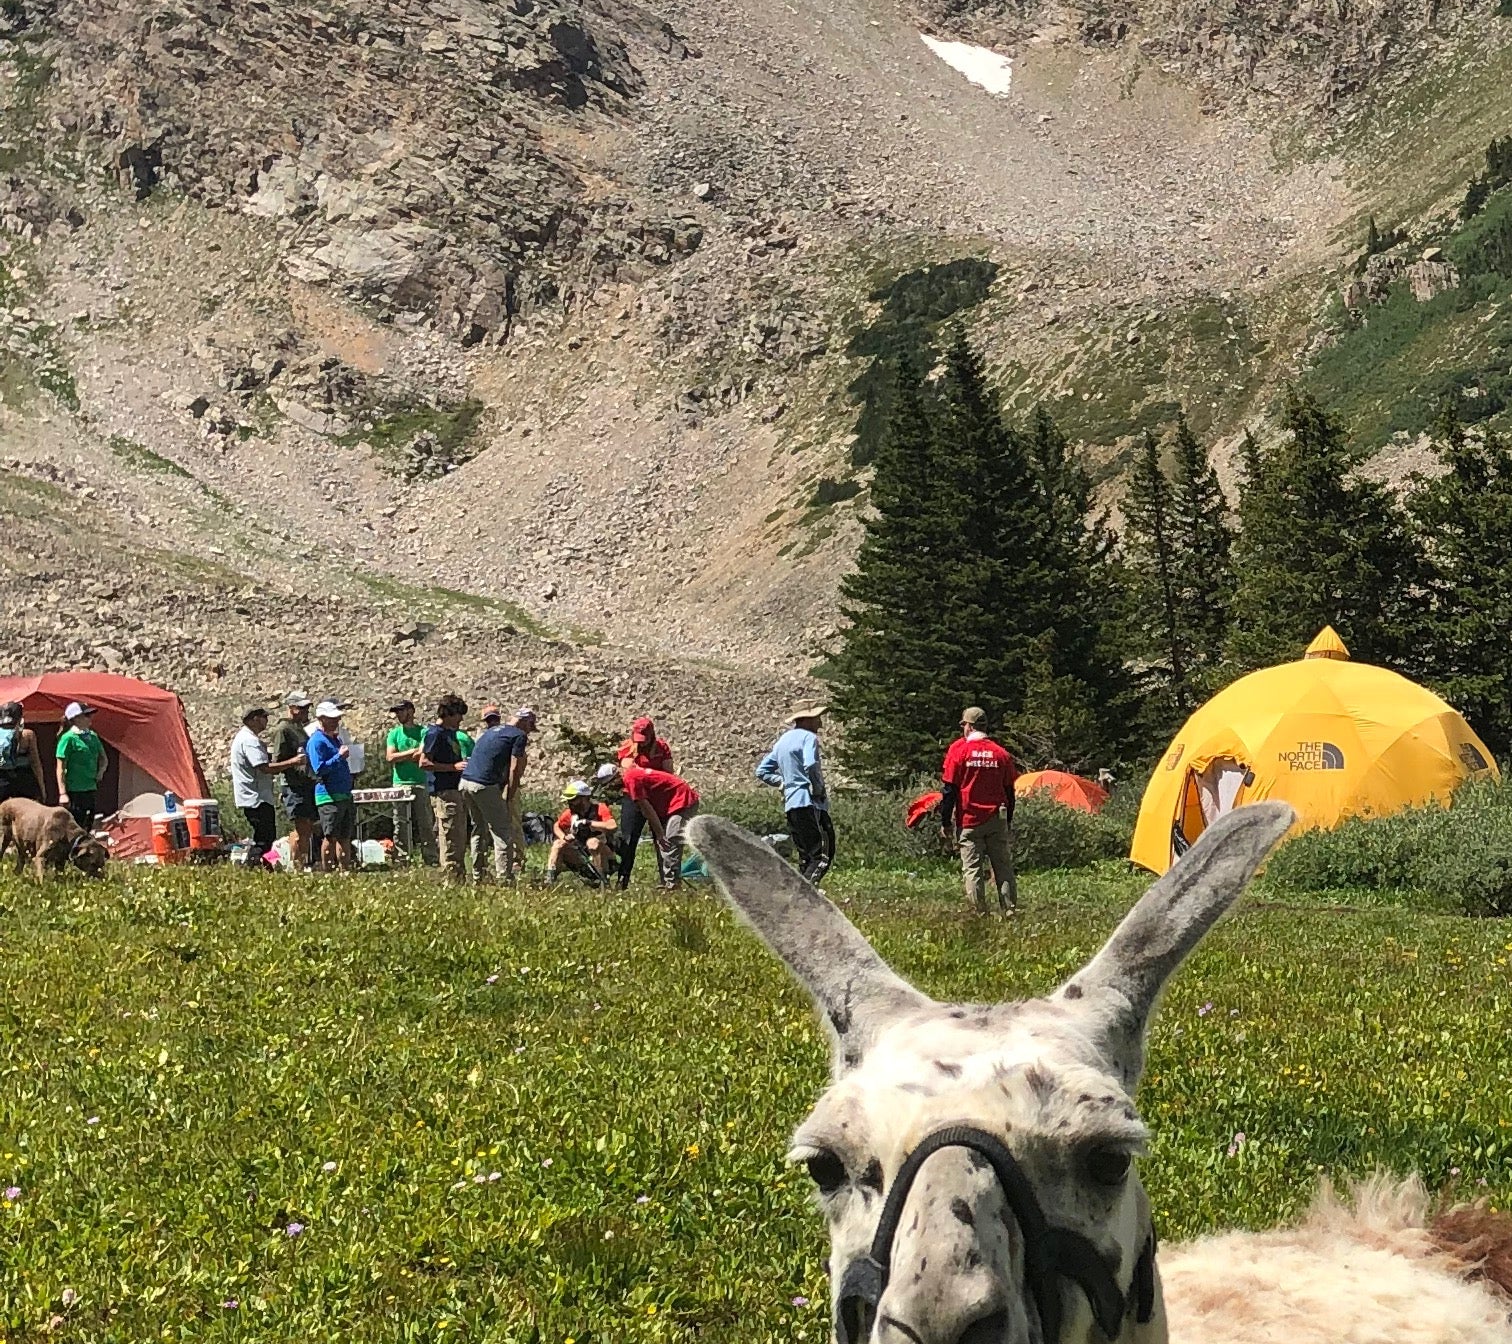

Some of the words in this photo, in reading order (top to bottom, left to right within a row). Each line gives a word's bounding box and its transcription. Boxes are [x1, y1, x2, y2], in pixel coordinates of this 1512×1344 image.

[1297, 742, 1321, 751] THE
[1278, 751, 1321, 762] NORTH
[1290, 761, 1321, 771] FACE
